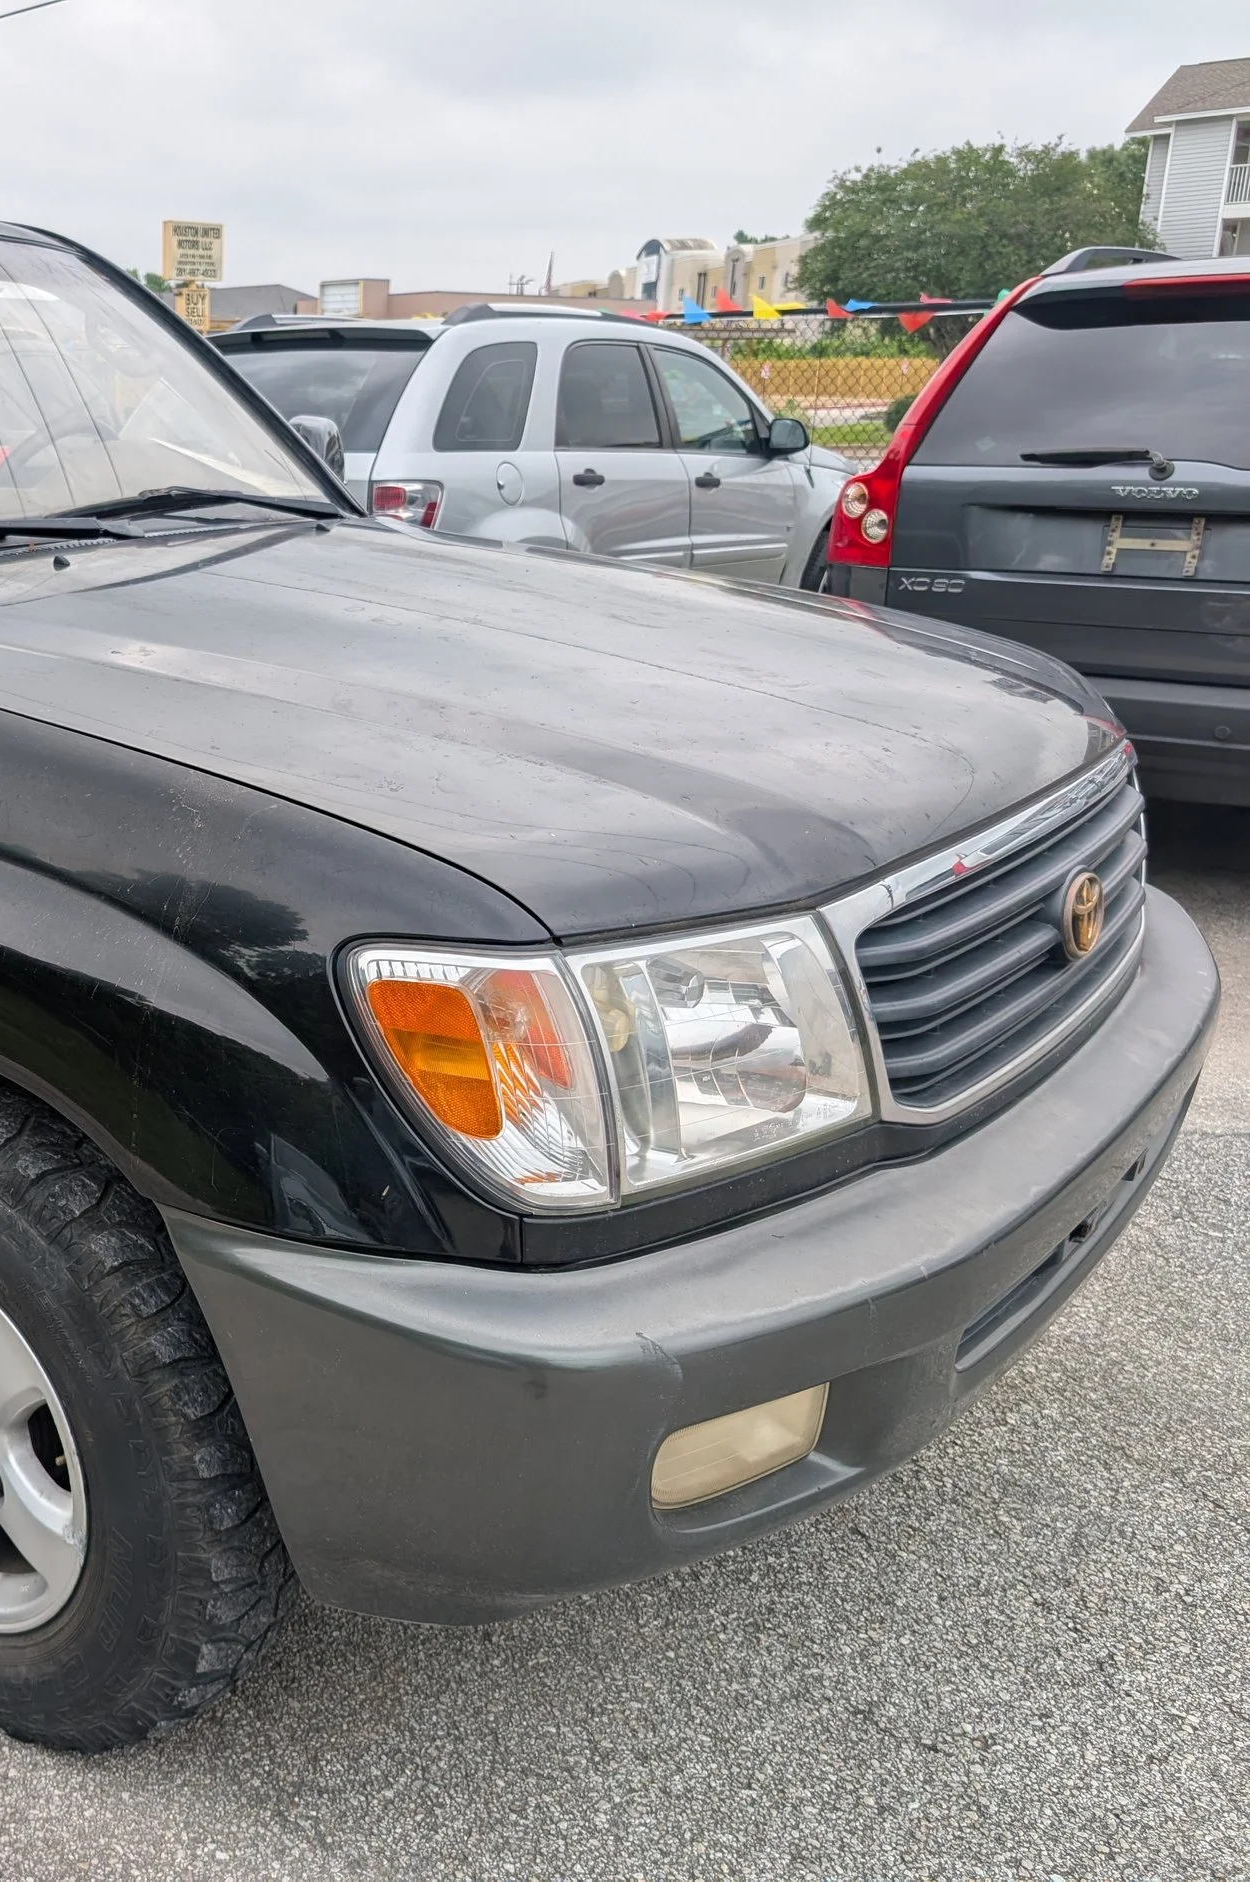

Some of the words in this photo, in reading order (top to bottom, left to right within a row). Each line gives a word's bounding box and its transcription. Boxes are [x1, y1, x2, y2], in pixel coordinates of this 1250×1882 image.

[173, 224, 199, 238] HOUSTON
[200, 226, 221, 239] UNITED
[177, 238, 200, 251] MOTORS
[201, 240, 213, 252] LLC
[185, 293, 207, 306] BUY
[185, 306, 206, 317] SELL
[1111, 486, 1199, 500] VOLVO
[97, 1526, 134, 1653] MUD
